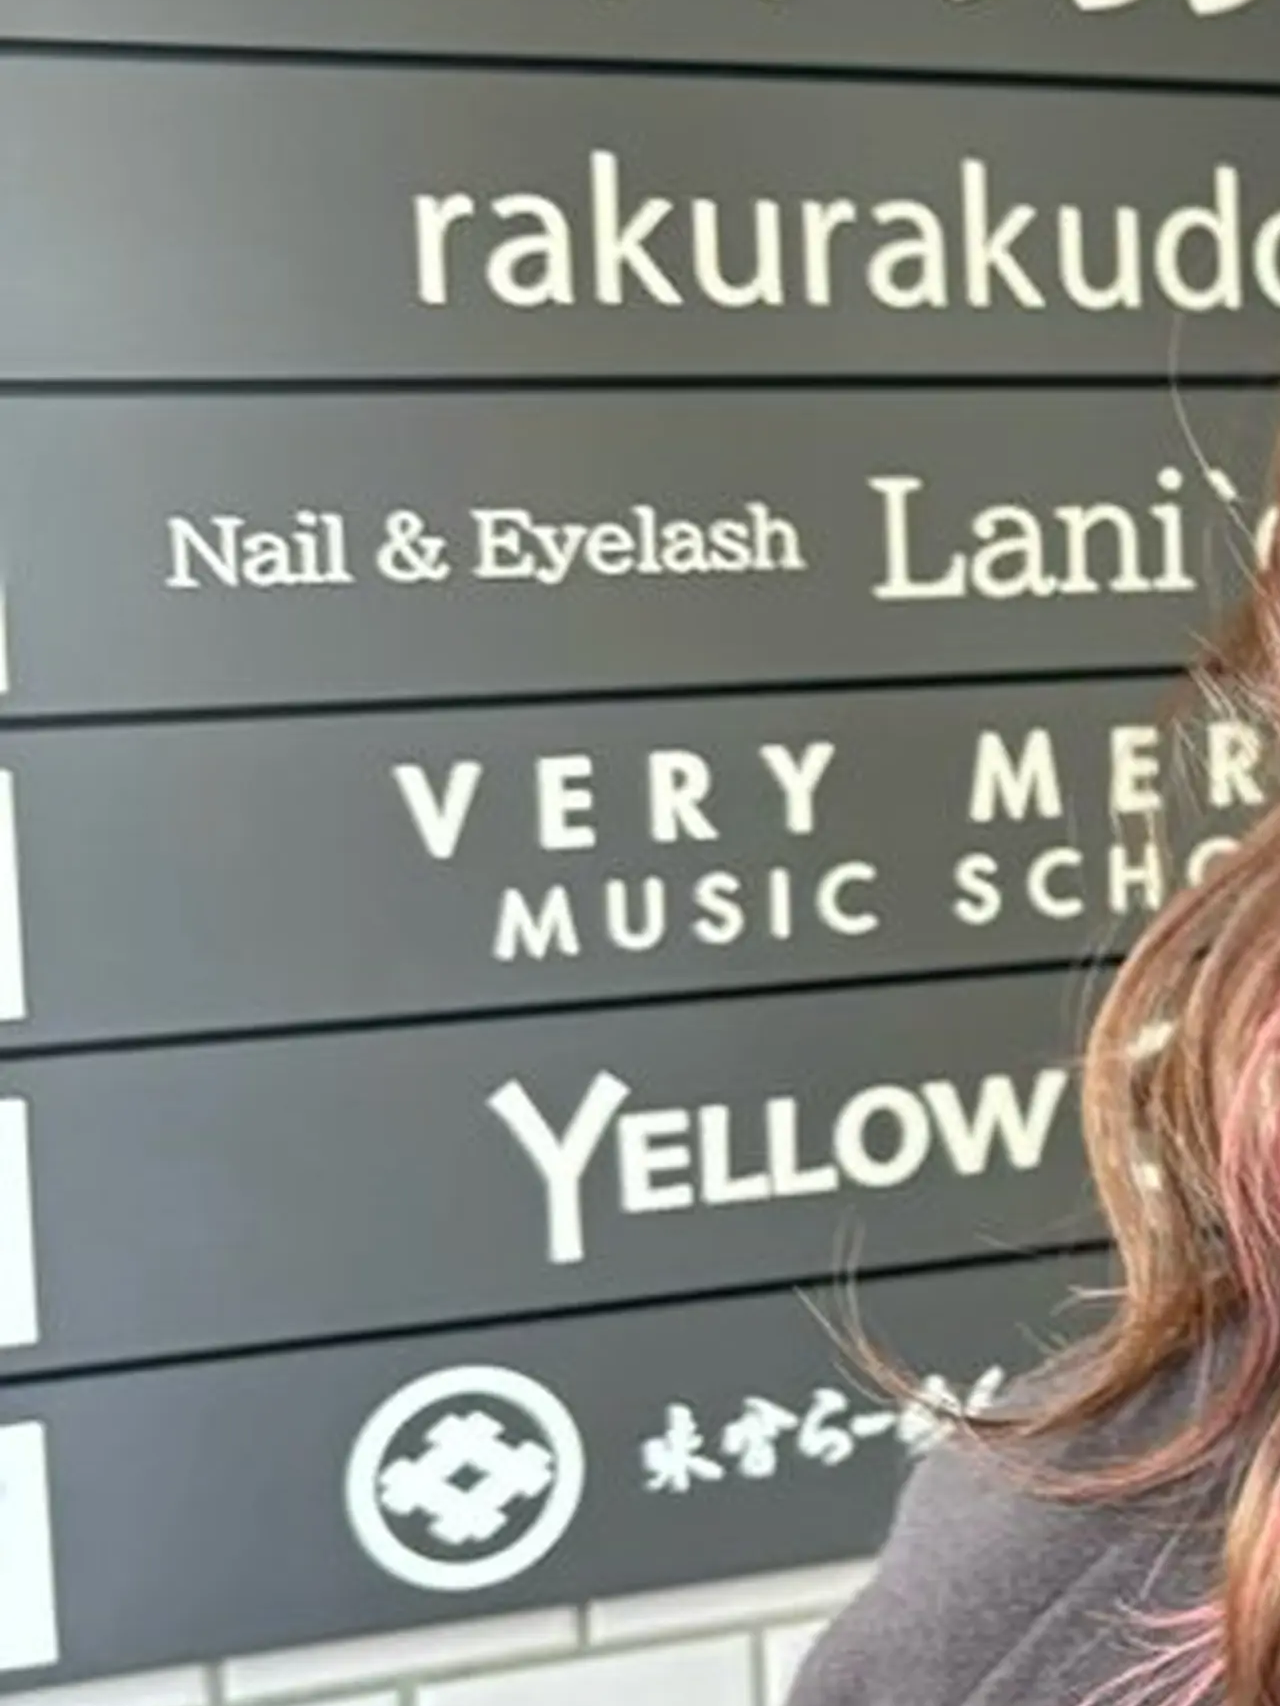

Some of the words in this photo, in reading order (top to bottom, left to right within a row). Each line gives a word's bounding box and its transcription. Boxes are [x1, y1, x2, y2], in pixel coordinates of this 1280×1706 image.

[164, 510, 354, 588] Nail
[376, 509, 451, 582] &
[470, 502, 808, 585] Eyelash
[392, 742, 835, 860] VERY
[493, 862, 878, 961] MUSIC
[487, 1070, 1068, 1264] YELLOW
